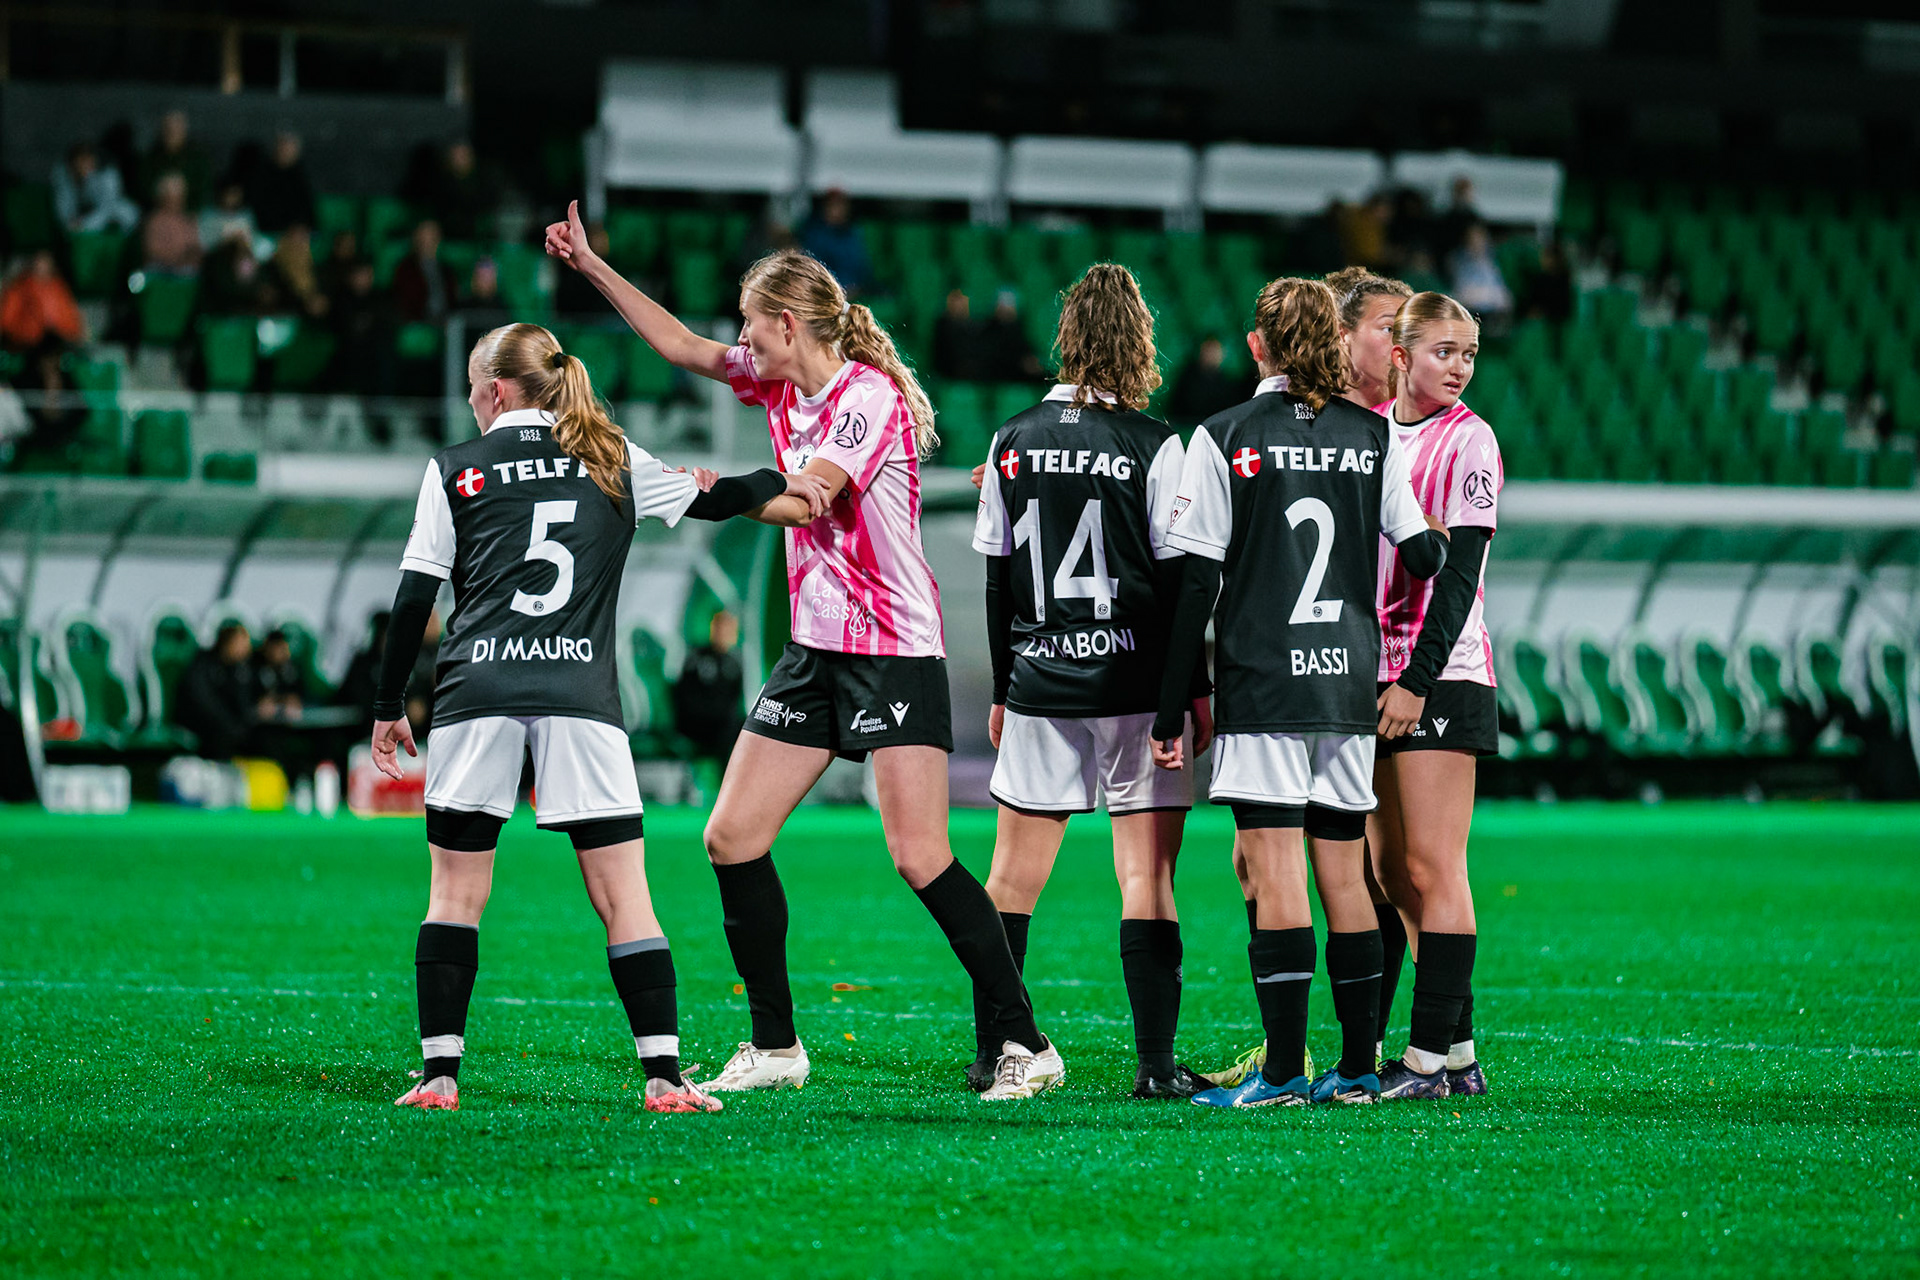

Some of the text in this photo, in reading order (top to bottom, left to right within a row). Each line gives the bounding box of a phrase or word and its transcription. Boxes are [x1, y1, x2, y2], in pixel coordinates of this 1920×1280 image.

[1059, 415, 1080, 424] 2026
[1062, 408, 1081, 416] 1951
[1295, 411, 1315, 420] 2026
[493, 457, 571, 484] TELF
[510, 500, 578, 617] 5
[1012, 498, 1119, 622] 14
[1284, 497, 1344, 625] 2
[811, 577, 832, 598] La
[471, 635, 594, 664] DI MAURO
[1290, 647, 1349, 676] BASSI
[759, 697, 784, 712] CHRIS
